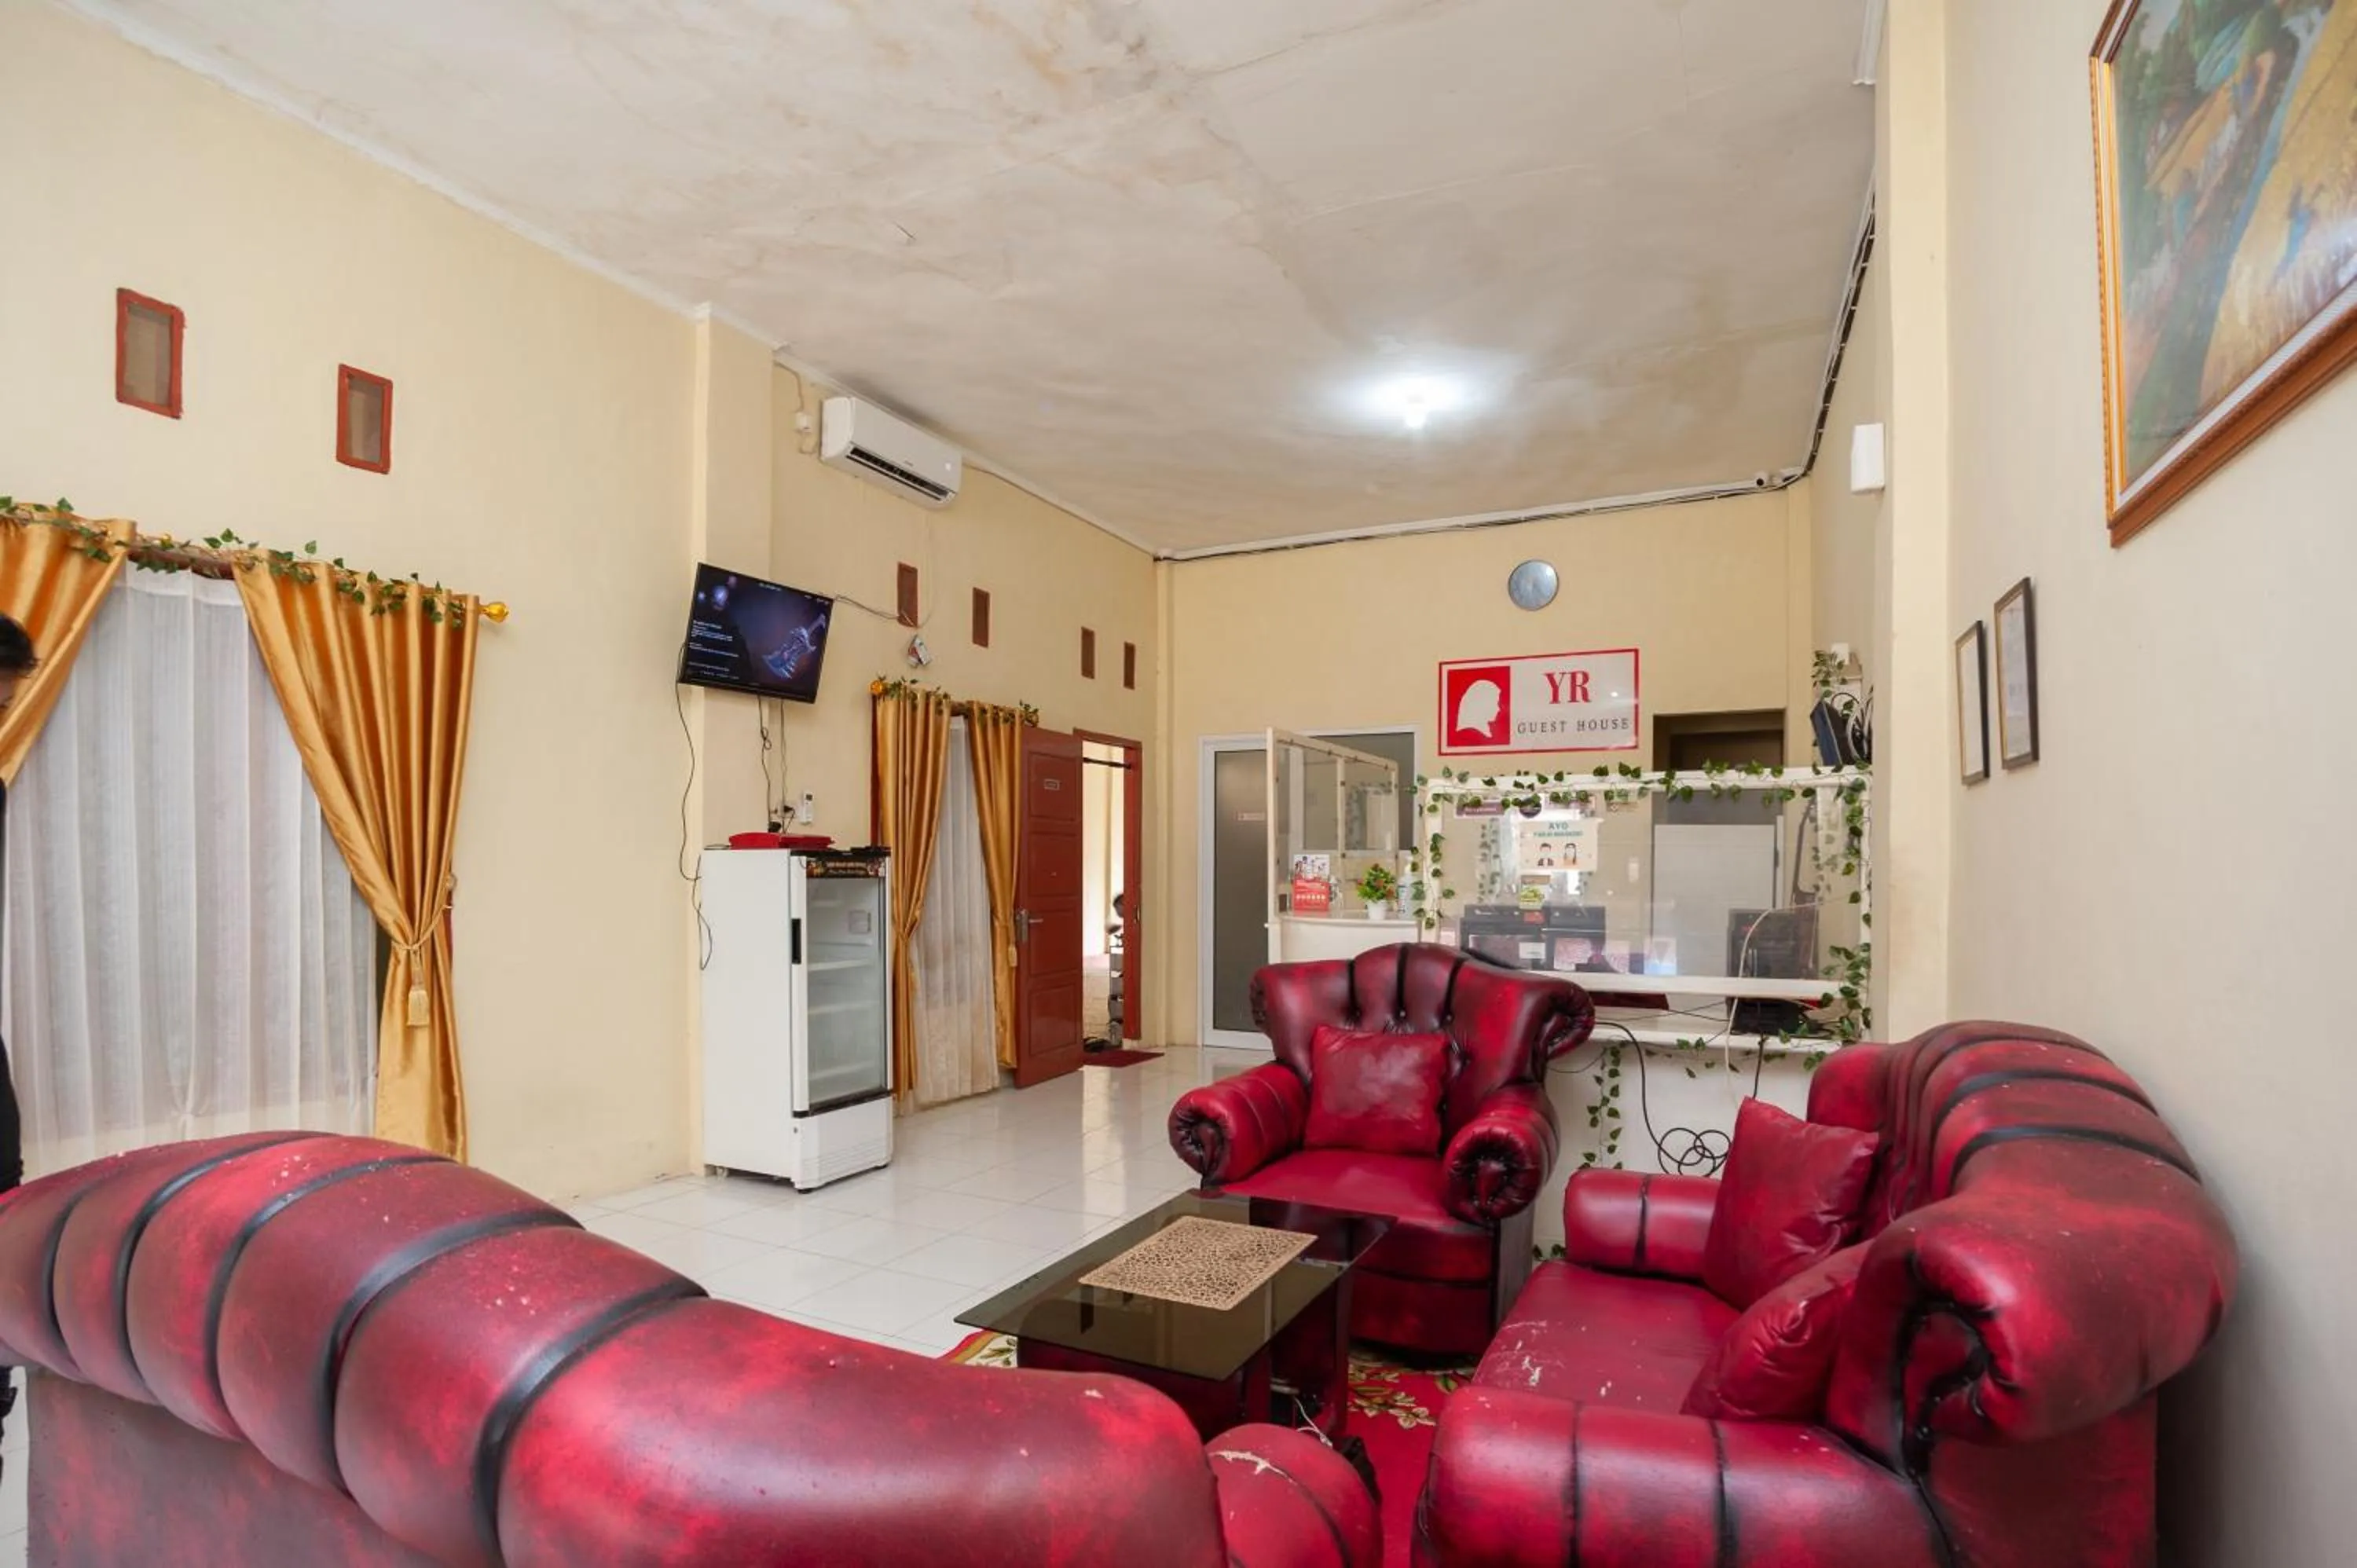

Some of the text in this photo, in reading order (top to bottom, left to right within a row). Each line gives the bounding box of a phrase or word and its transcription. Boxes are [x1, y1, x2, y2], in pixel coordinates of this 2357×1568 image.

[1543, 670, 1592, 704] YR
[1517, 718, 1629, 734] GUEST HOUSE
